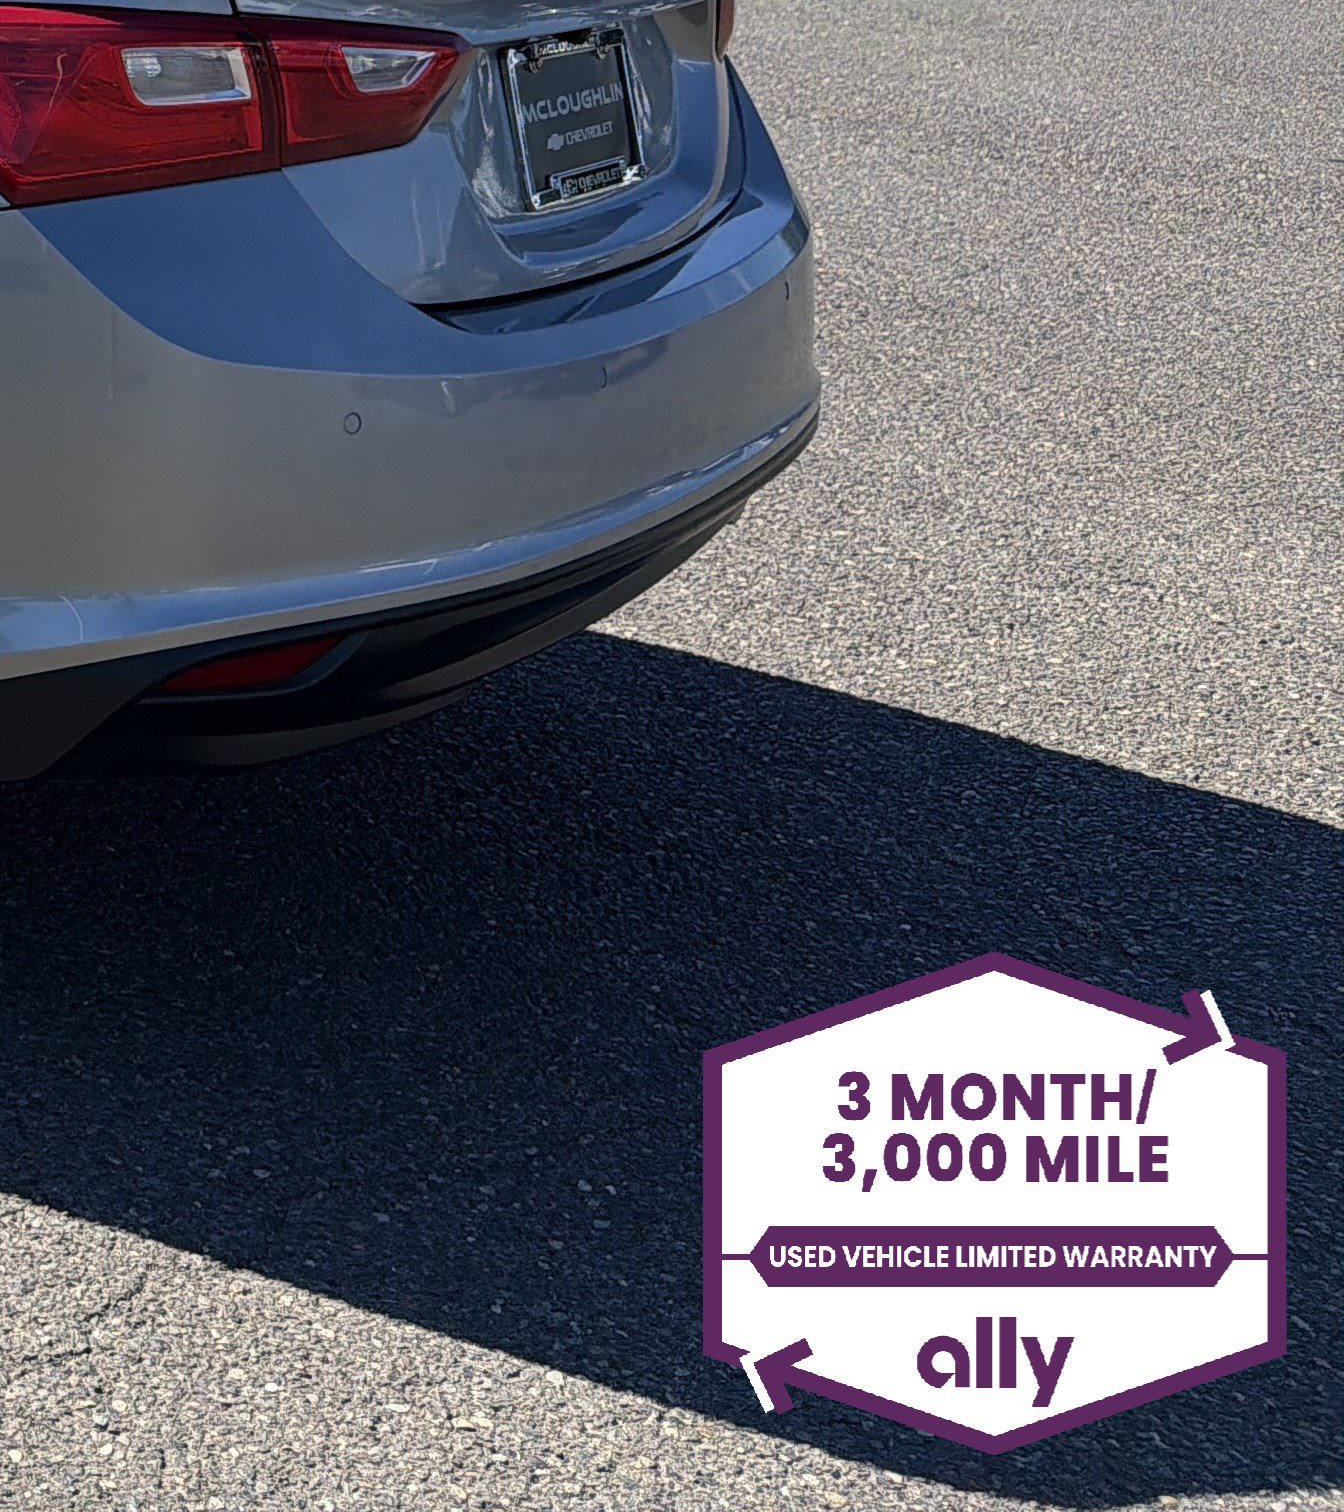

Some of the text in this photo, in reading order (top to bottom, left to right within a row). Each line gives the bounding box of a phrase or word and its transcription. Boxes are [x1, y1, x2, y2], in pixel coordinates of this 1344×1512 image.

[522, 82, 624, 124] MCLOUGHLIN
[565, 120, 613, 145] CHEVROLET
[578, 167, 623, 190] CHEVROLET
